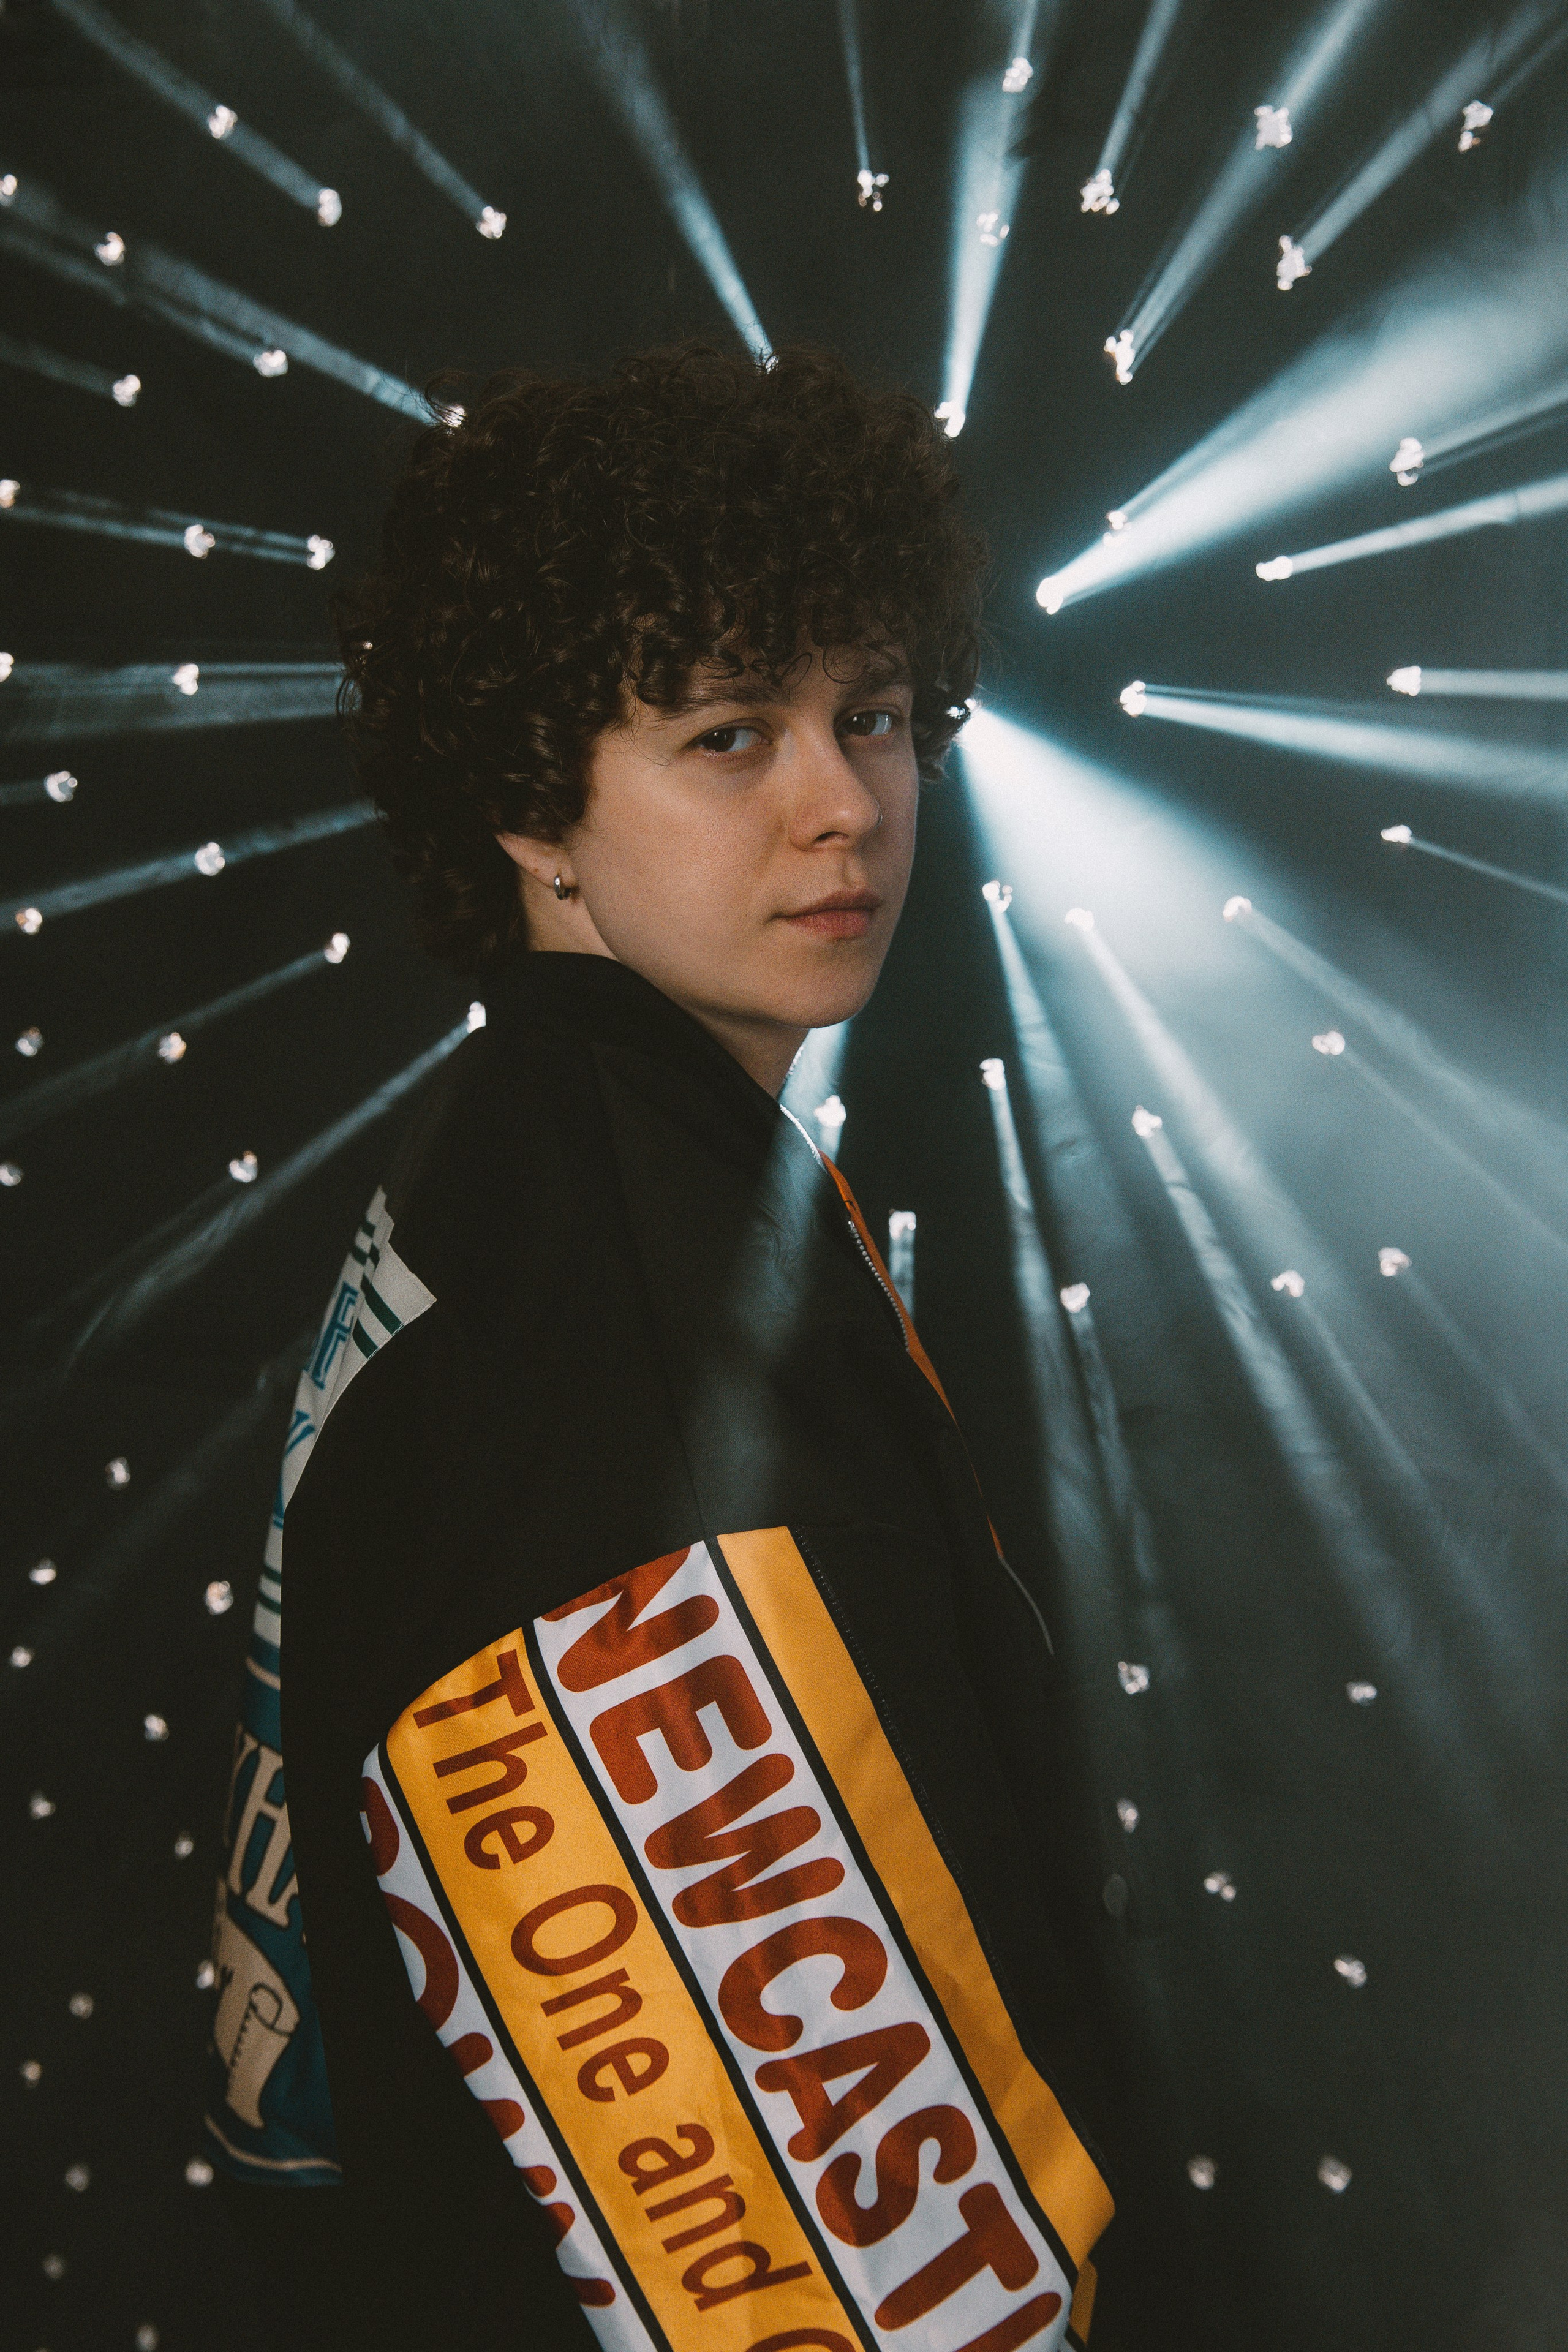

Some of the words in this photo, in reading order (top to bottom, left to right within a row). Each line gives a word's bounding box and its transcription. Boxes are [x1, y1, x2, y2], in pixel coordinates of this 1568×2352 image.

[412, 1648, 556, 1871] The
[510, 1883, 671, 2103] One
[617, 2123, 813, 2313] and
